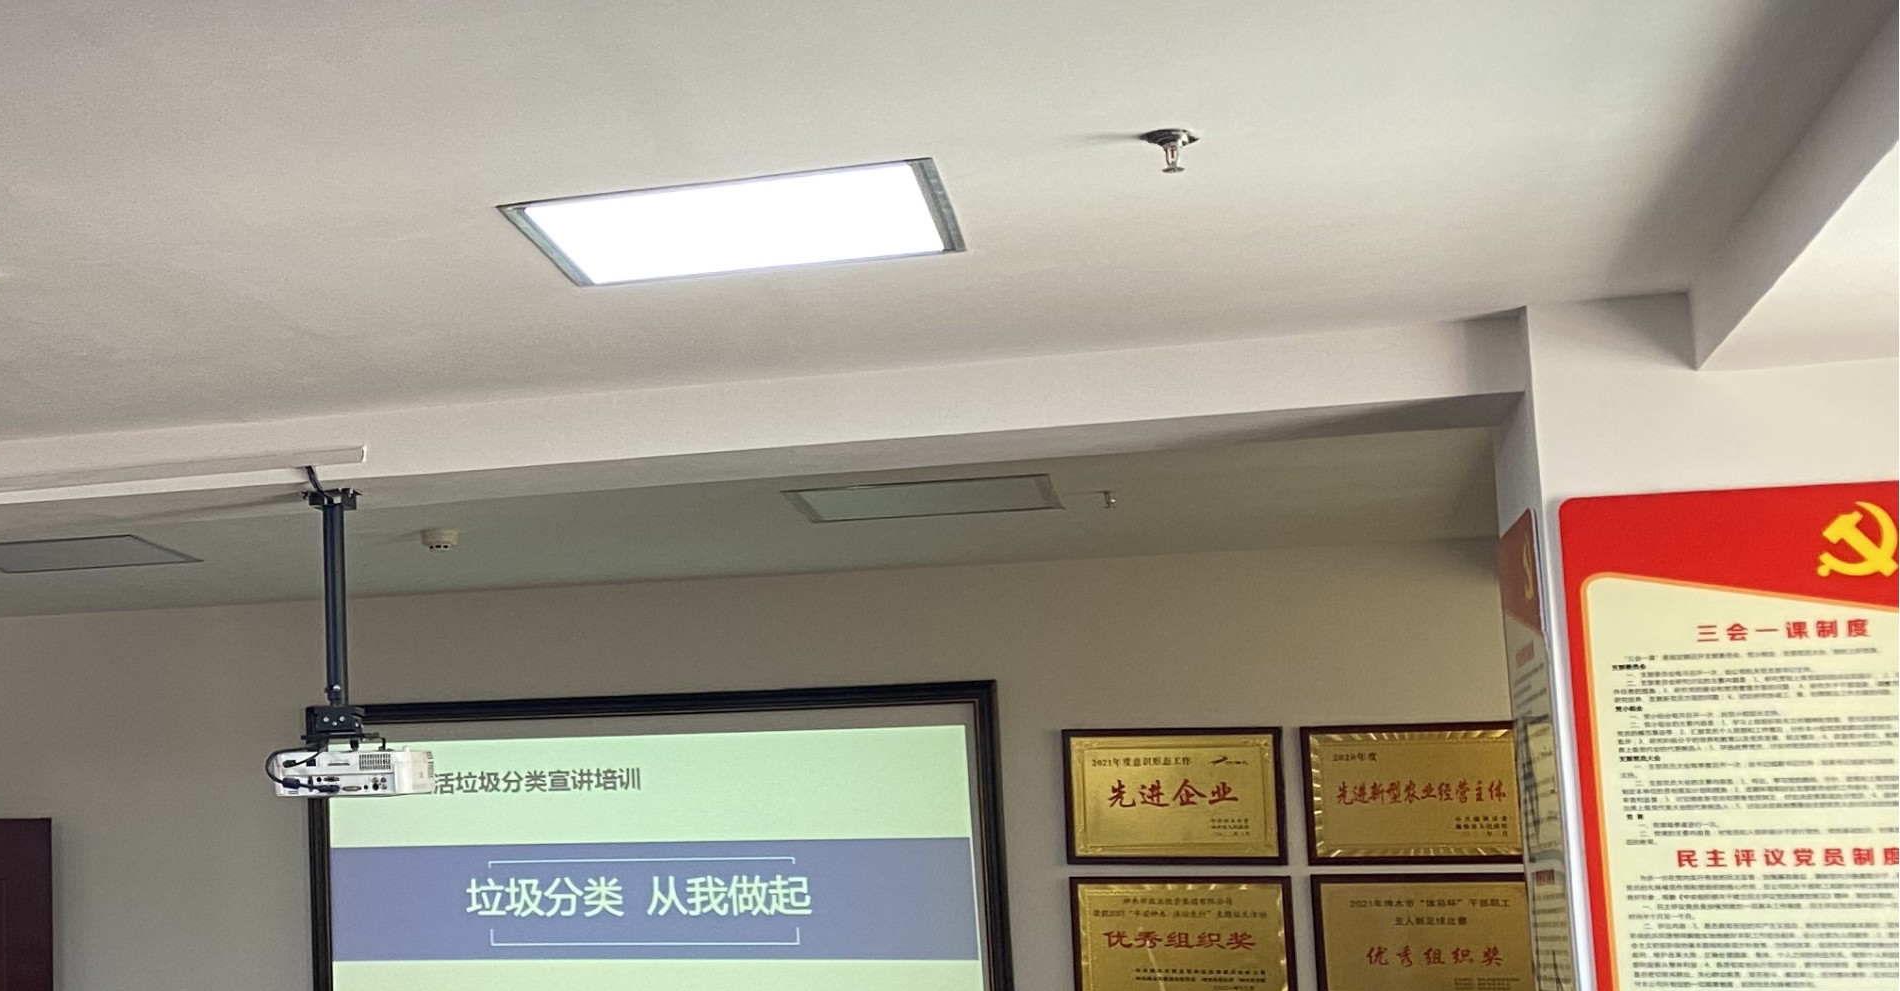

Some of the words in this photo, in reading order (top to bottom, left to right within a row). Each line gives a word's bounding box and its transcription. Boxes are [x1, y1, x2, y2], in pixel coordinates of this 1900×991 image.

[1697, 619, 1870, 643] 三会一课制度
[1108, 779, 1239, 807] 先进企业
[1337, 779, 1506, 805] 先进新型农业经营主体
[465, 875, 624, 917] 垃圾分类
[646, 875, 812, 917] 从我做起
[1103, 930, 1255, 950] 优秀组织奖
[1366, 946, 1503, 967] 优秀组织奖
